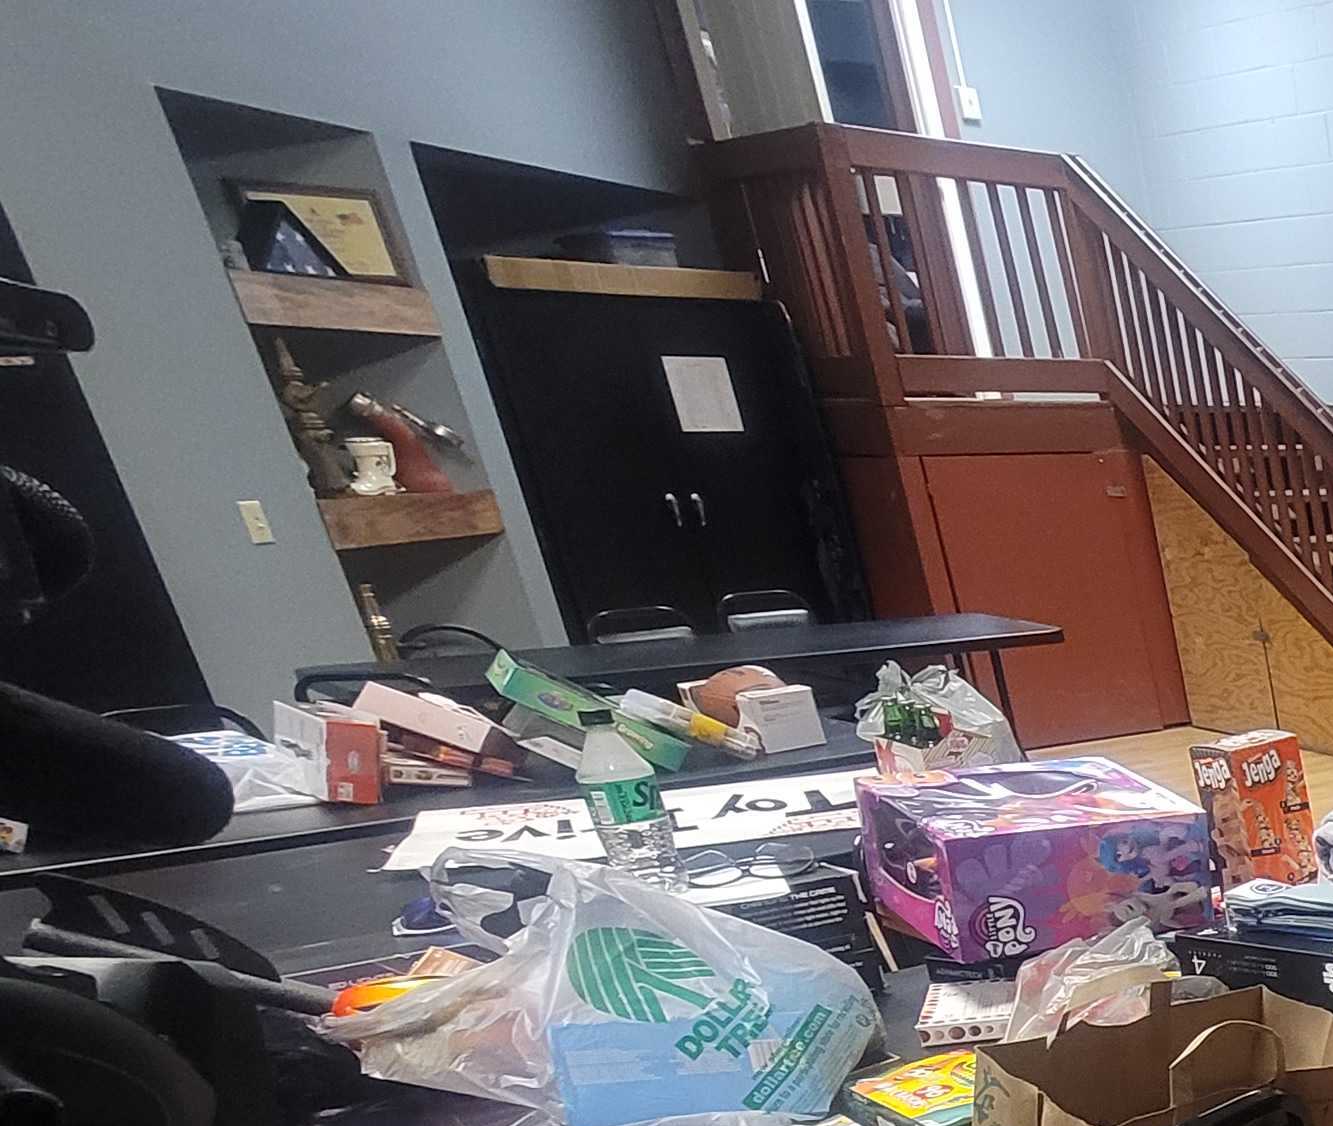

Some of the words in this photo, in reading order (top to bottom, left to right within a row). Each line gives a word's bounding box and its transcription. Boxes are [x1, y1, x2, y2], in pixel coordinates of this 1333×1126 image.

[1194, 758, 1231, 790] Jenga
[1242, 749, 1281, 788] Jenga
[713, 788, 859, 820] Toy
